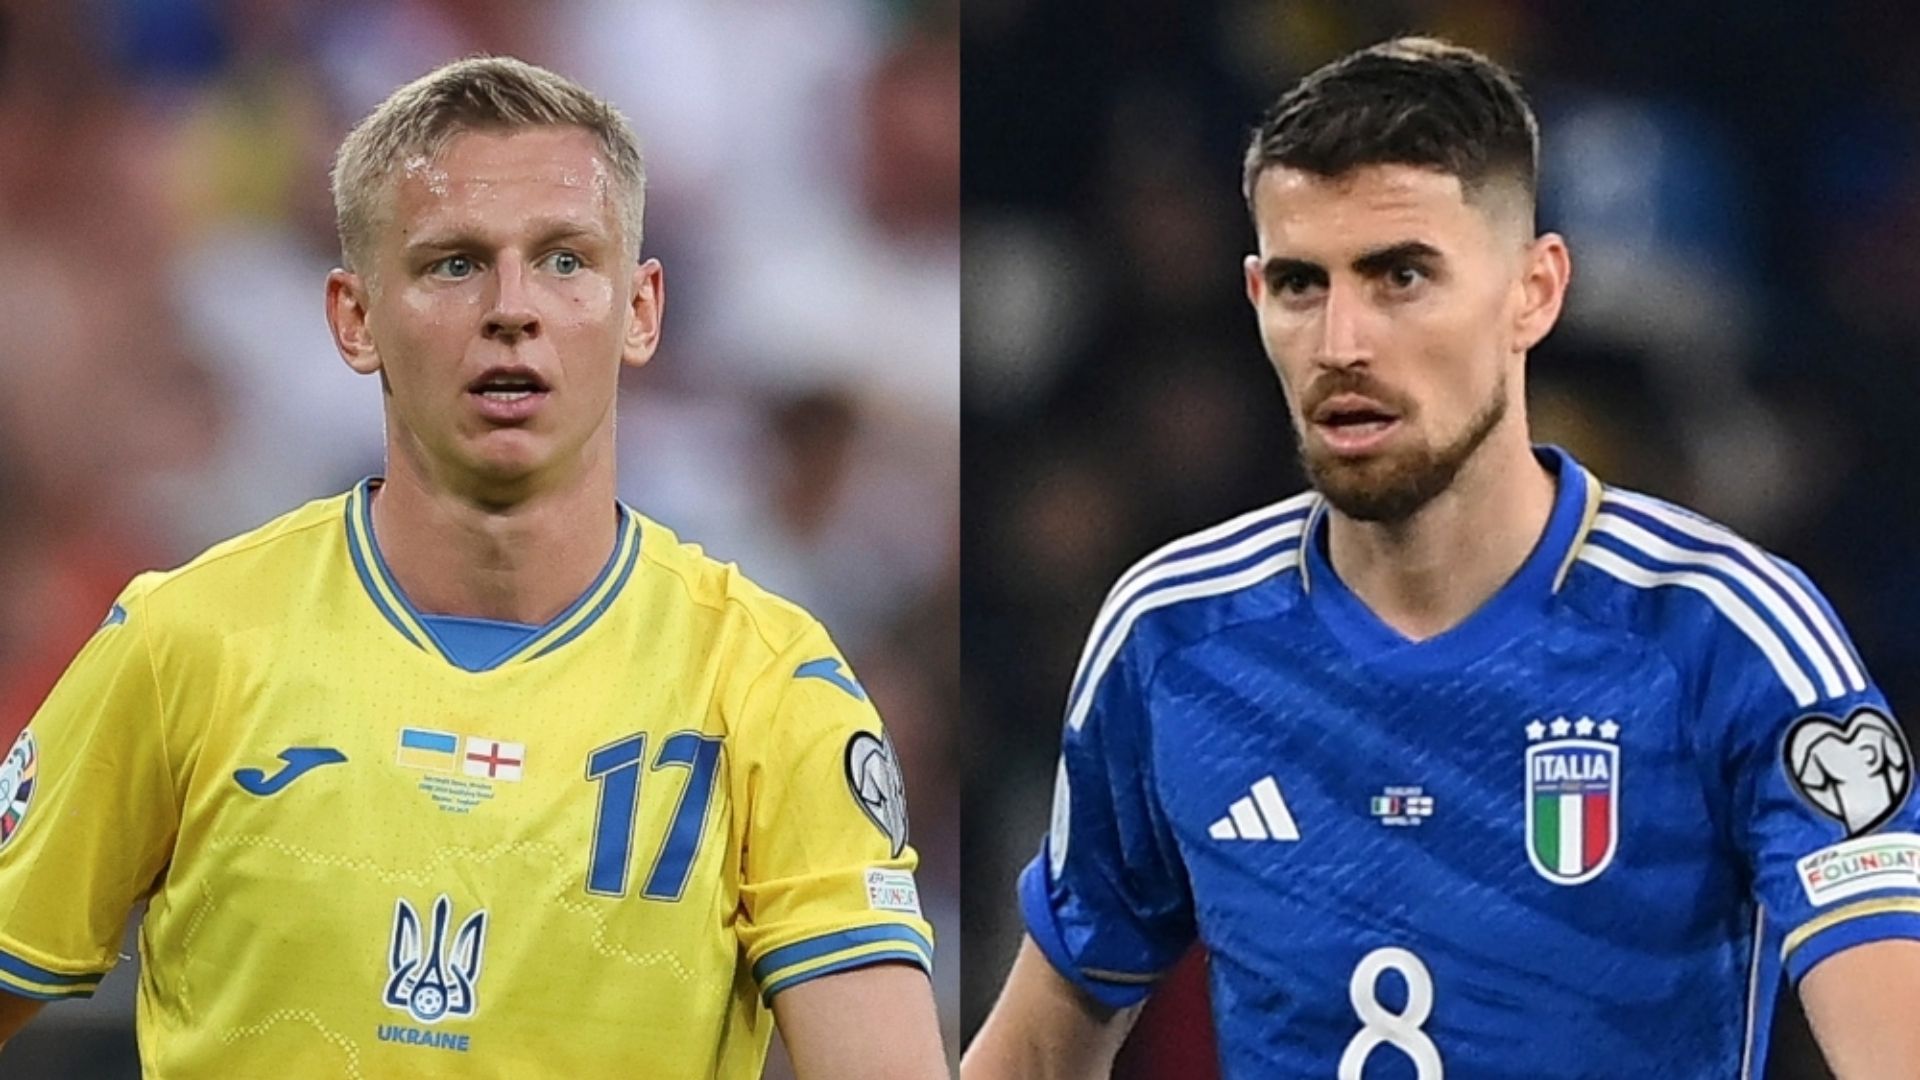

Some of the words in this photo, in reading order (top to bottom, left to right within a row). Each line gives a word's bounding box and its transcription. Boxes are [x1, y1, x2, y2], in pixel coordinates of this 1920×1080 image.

[1535, 754, 1609, 782] ITALIA
[586, 730, 724, 902] 17
[378, 1024, 470, 1052] UKRAINE
[1338, 946, 1443, 1080] 8
